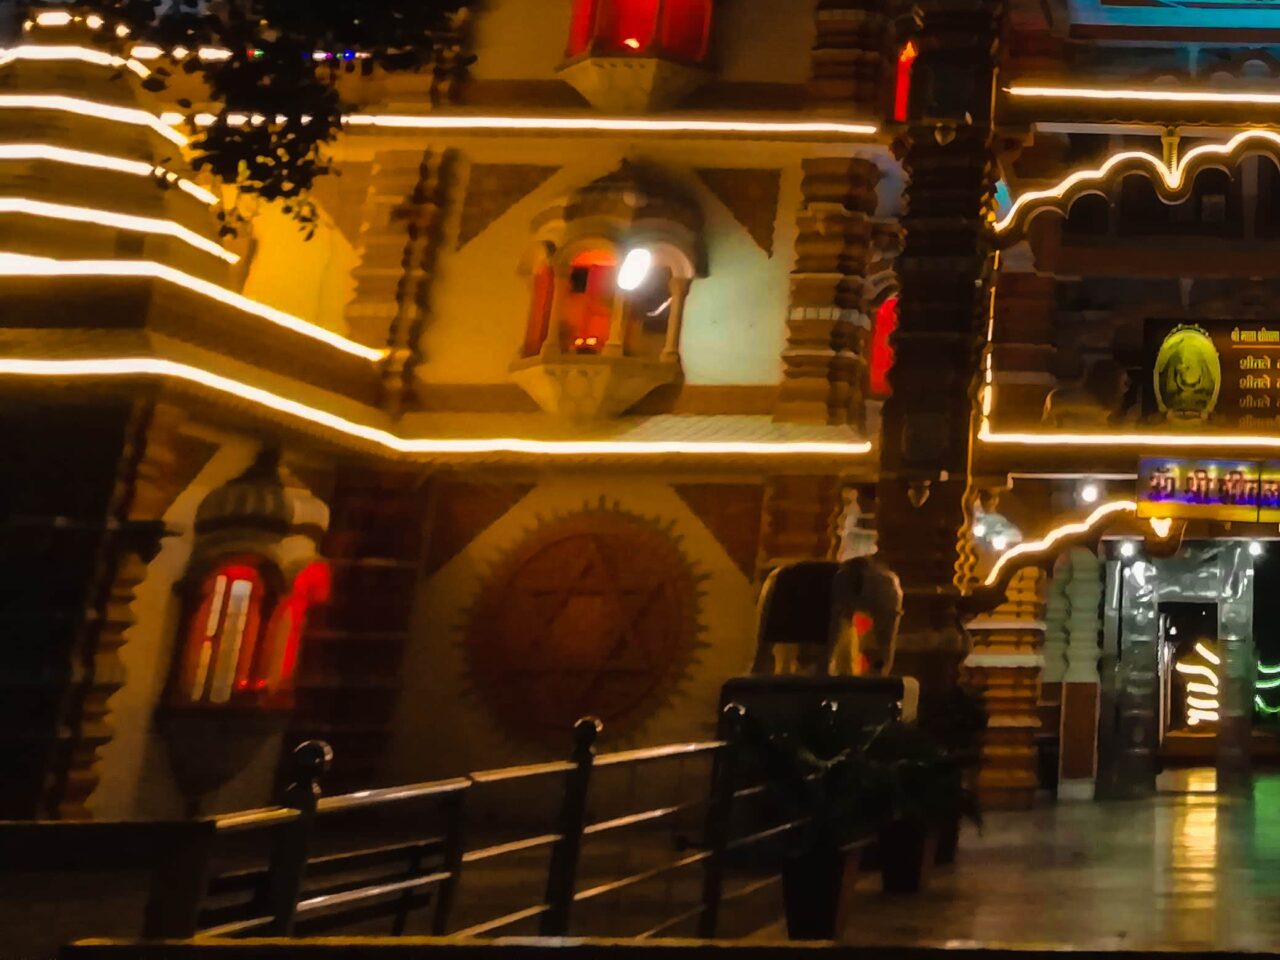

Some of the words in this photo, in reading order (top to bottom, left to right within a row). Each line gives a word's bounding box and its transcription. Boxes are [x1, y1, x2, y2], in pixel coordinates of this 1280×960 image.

[1240, 355, 1271, 369] शीतले
[1240, 374, 1271, 389] शीतले
[1240, 394, 1271, 408] शीतले
